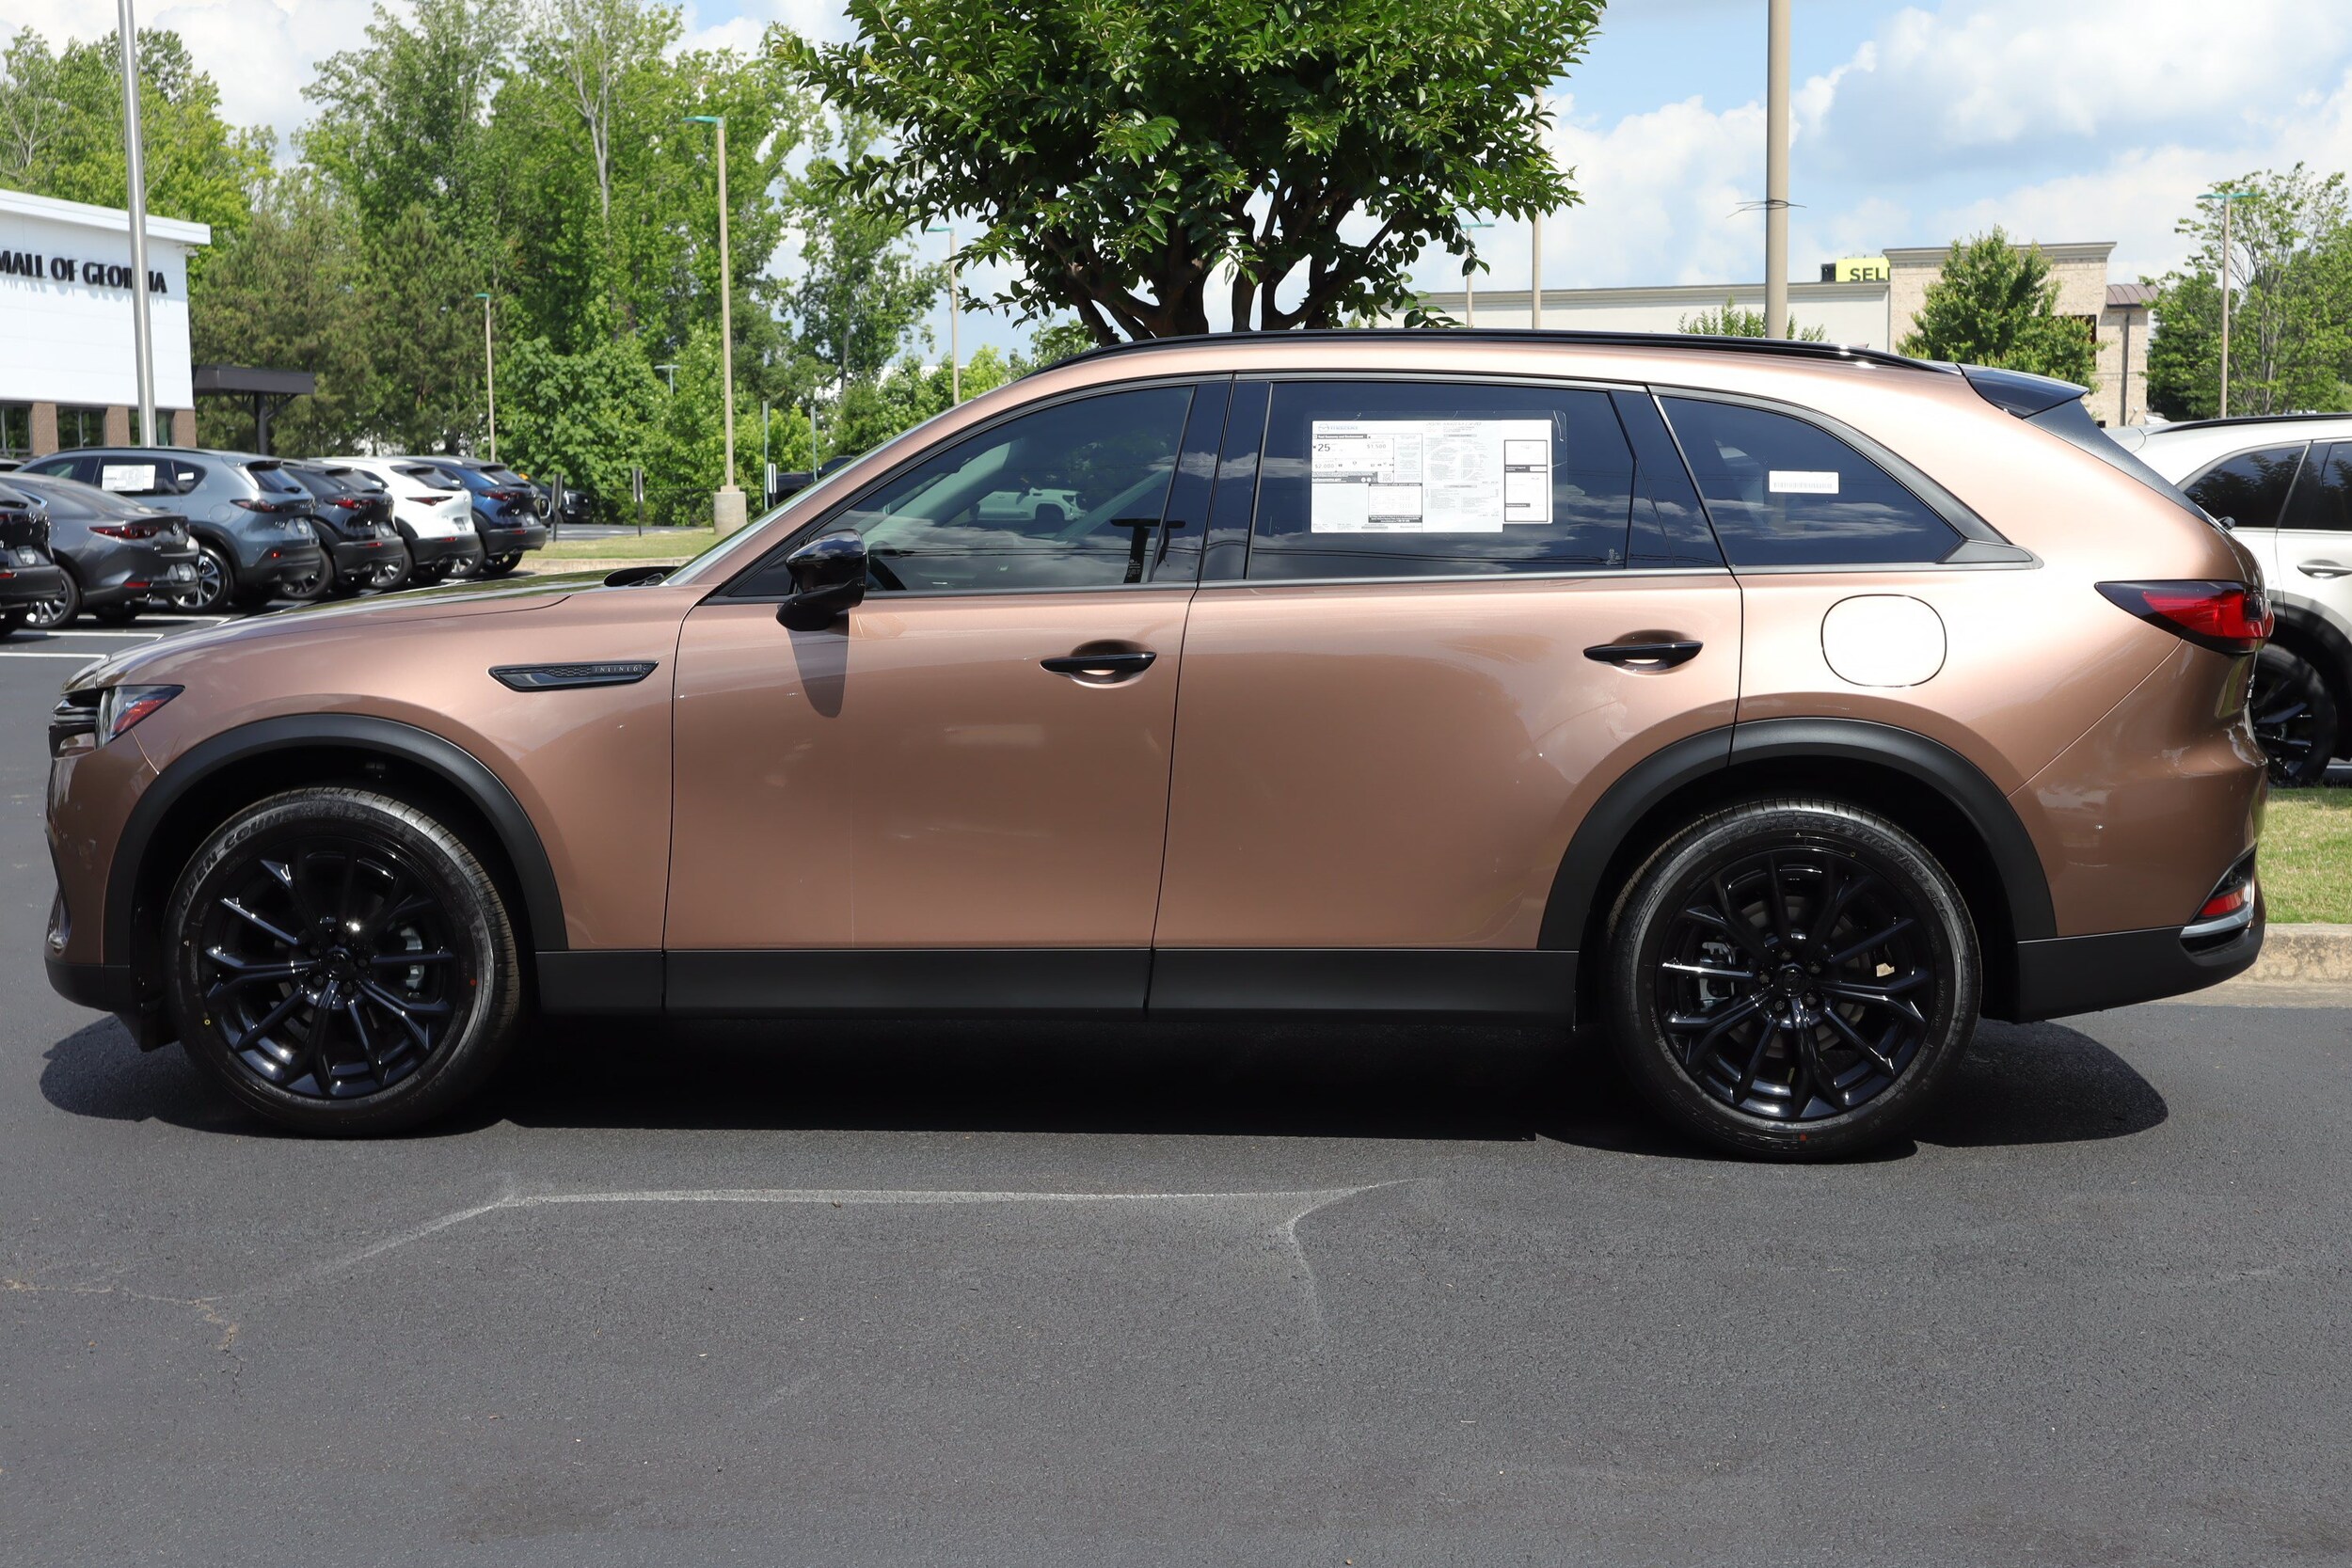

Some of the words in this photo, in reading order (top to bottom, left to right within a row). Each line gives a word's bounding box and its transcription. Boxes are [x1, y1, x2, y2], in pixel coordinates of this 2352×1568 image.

[0, 250, 47, 278] MALL
[51, 257, 78, 282] OF
[1850, 267, 1890, 281] SEL
[1317, 443, 1331, 452] 25
